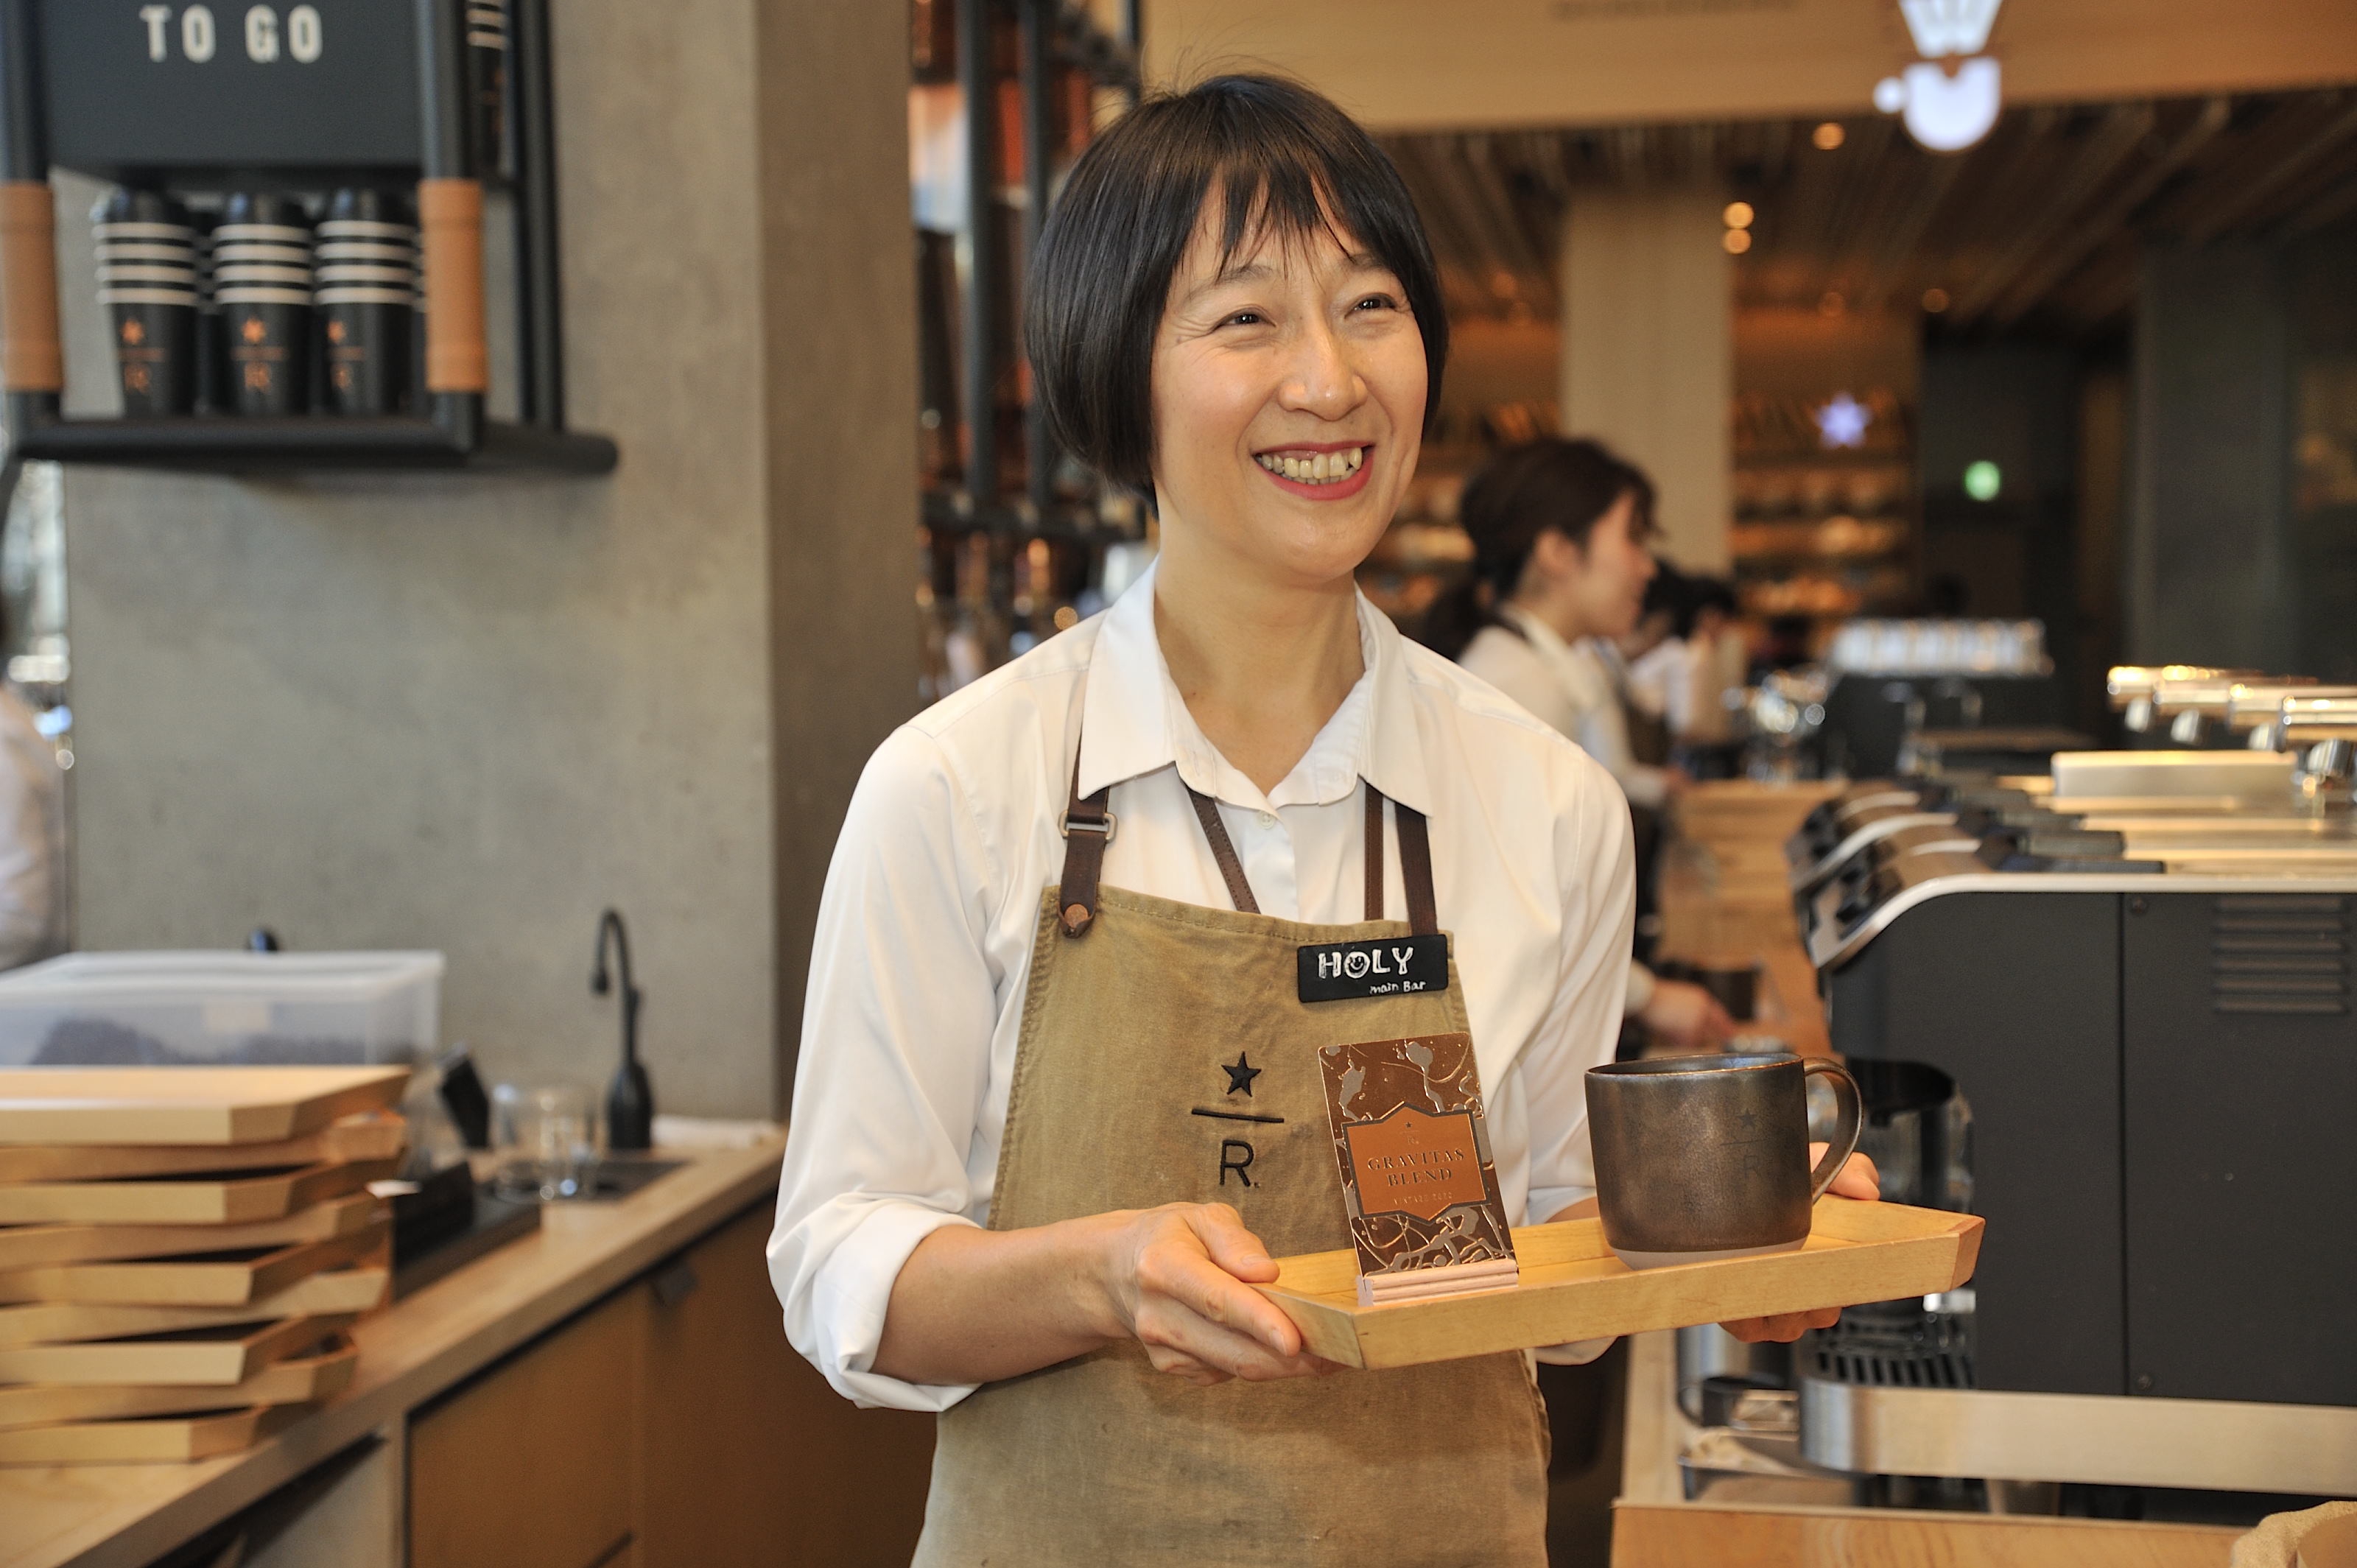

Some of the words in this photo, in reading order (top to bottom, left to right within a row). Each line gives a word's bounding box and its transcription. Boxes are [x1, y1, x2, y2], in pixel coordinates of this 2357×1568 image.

[138, 4, 217, 64] TO
[245, 4, 323, 64] GO
[1318, 946, 1414, 980] HOLY
[1369, 982, 1399, 994] main
[1403, 980, 1426, 993] Bar
[1367, 1147, 1464, 1170] GRAVITAS
[1387, 1168, 1452, 1186] BLEND
